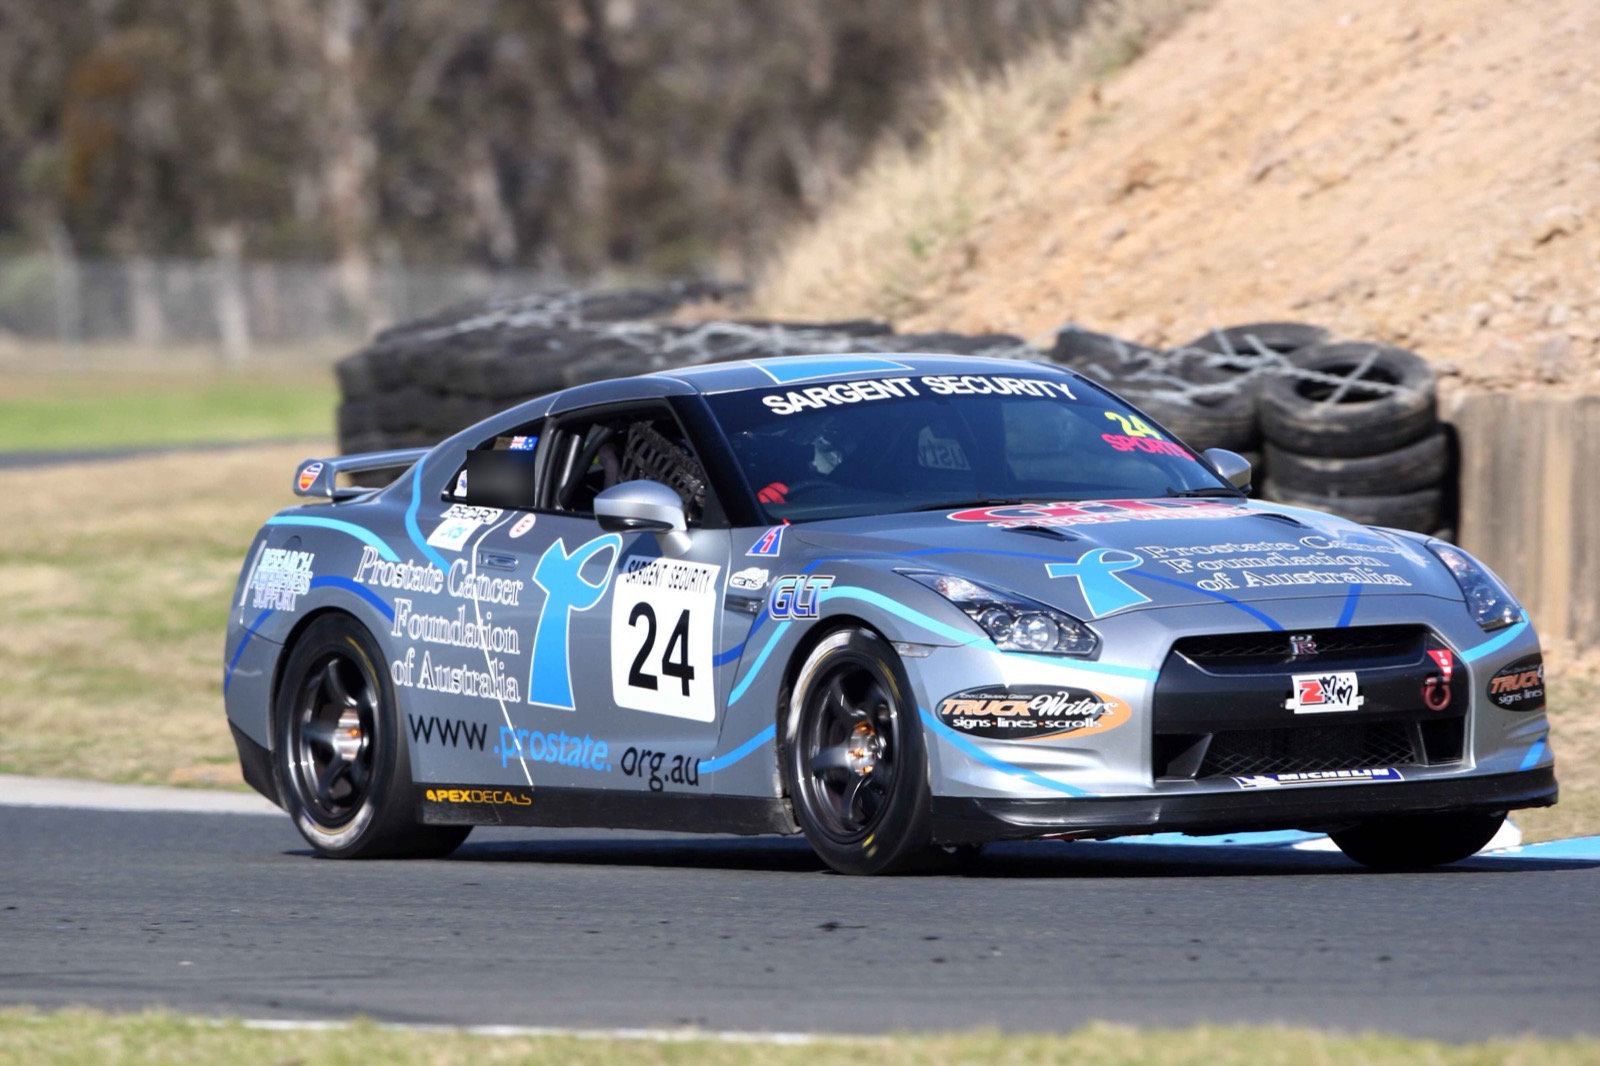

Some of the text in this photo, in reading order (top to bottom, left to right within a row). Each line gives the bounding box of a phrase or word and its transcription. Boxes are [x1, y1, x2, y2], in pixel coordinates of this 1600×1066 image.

[762, 376, 1077, 415] SARGENT SECURITY
[1104, 411, 1163, 440] 24
[1101, 433, 1196, 461] SPORTS
[258, 547, 315, 573] RESEARCH
[1135, 541, 1300, 559] Prostate
[1160, 551, 1390, 574] Foundation
[353, 545, 523, 606] Prostate Cancer
[626, 559, 714, 594] SARGENT SECURITY
[1196, 567, 1413, 591] of Australia
[253, 589, 297, 612] SUPPORT
[769, 574, 836, 620] GLT
[391, 598, 520, 655] Foundation
[628, 601, 695, 697] 24
[391, 647, 521, 703] of Australia
[941, 690, 1119, 716] TRUCK Writers
[953, 717, 1102, 729] signs lines scrolls
[621, 747, 700, 791] org.au
[1277, 767, 1390, 781] MICHELIN
